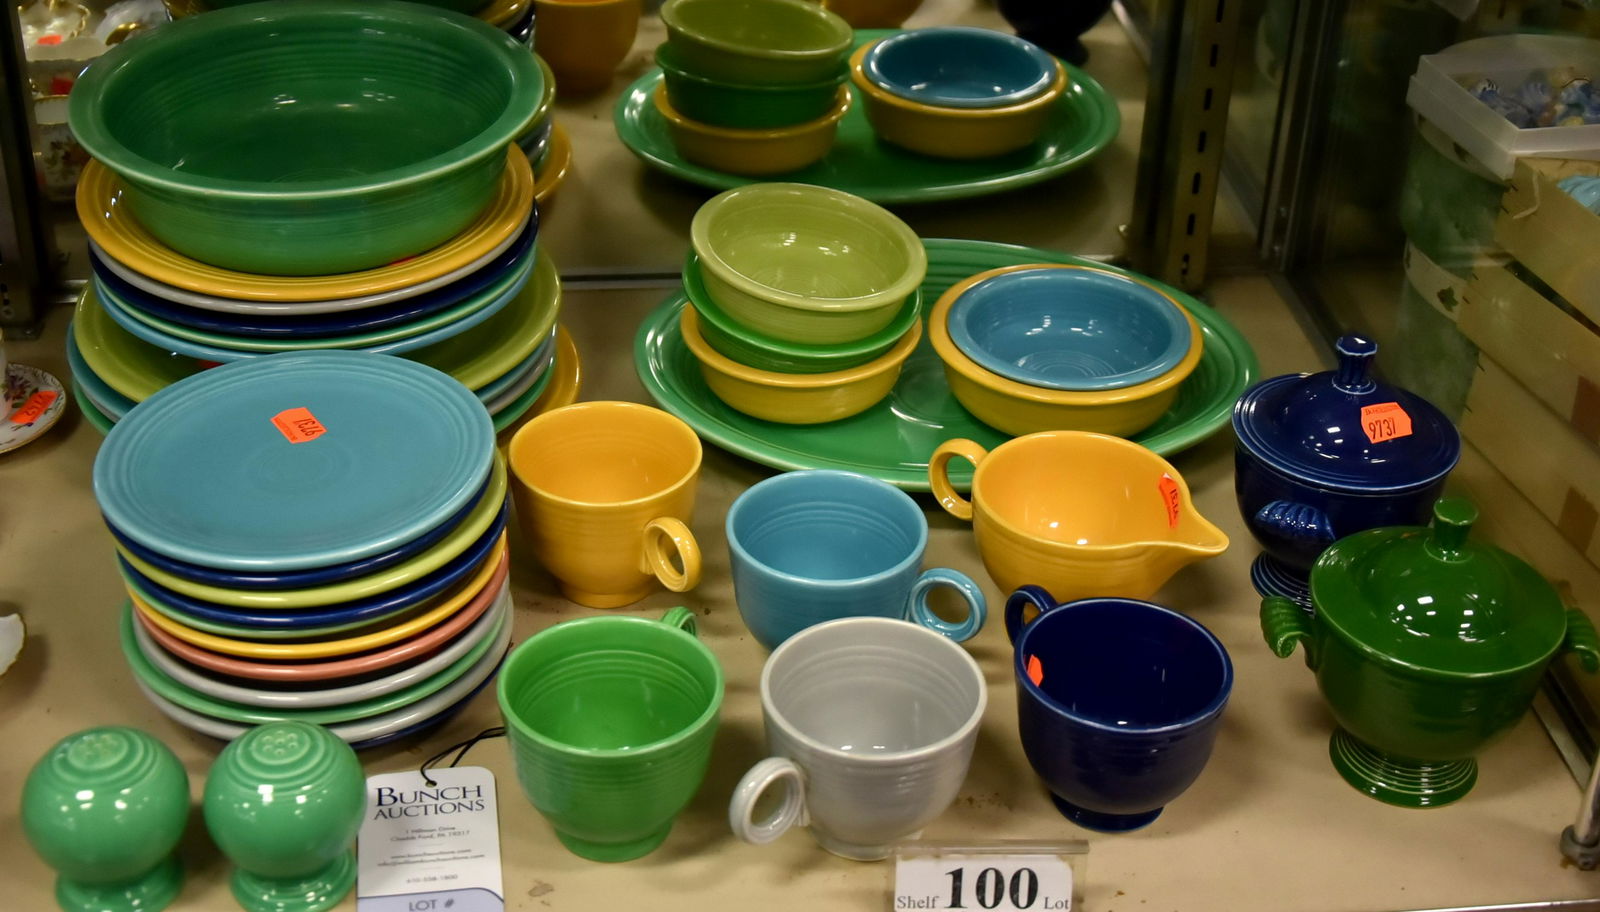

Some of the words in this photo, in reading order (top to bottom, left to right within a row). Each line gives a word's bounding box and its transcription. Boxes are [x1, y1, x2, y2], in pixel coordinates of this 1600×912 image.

[373, 799, 486, 820] AUCTIONS
[897, 895, 940, 909] Shelf
[944, 867, 1039, 910] 100
[1044, 897, 1069, 910] Lot
[409, 899, 438, 912] LOT
